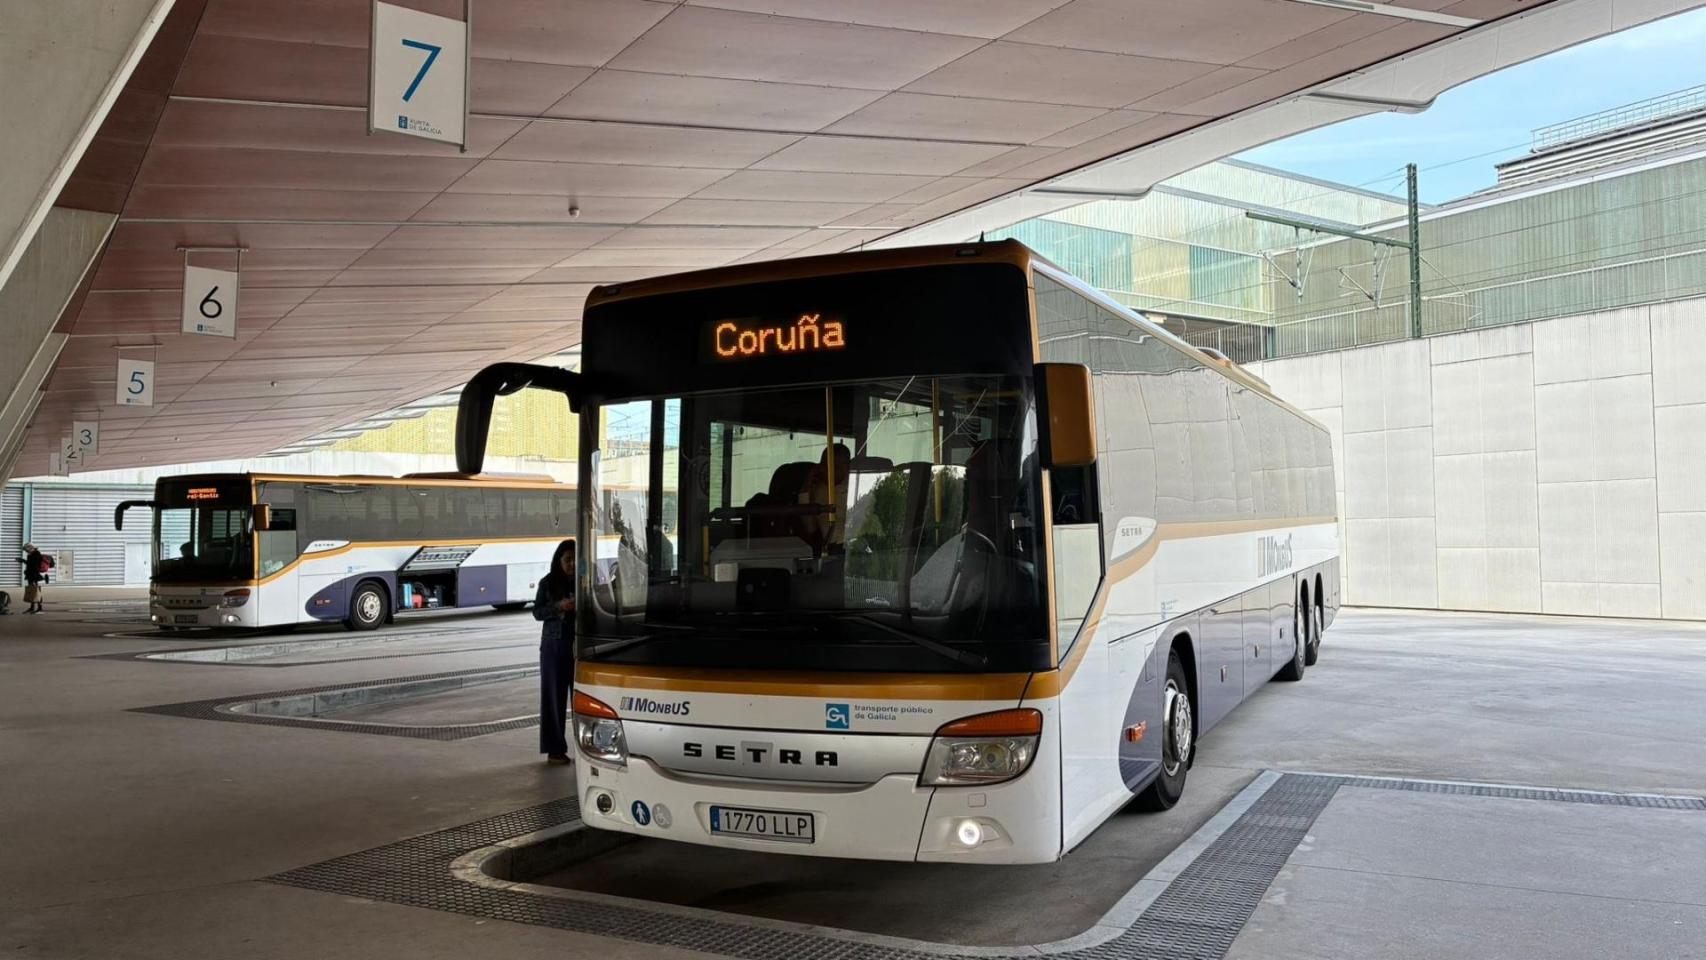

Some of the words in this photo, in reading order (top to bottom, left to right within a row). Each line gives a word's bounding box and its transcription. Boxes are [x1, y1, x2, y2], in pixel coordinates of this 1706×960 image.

[401, 38, 442, 102] 7
[199, 285, 222, 319] 6
[716, 313, 846, 356] Coruña
[128, 371, 145, 394] 5
[80, 429, 92, 445] 3
[67, 444, 78, 459] 2
[854, 704, 899, 713] transporte
[900, 705, 934, 714] público
[867, 713, 897, 721] Galicia
[683, 742, 839, 767] SETRA
[725, 811, 767, 833] 1770
[773, 815, 807, 836] LLP
